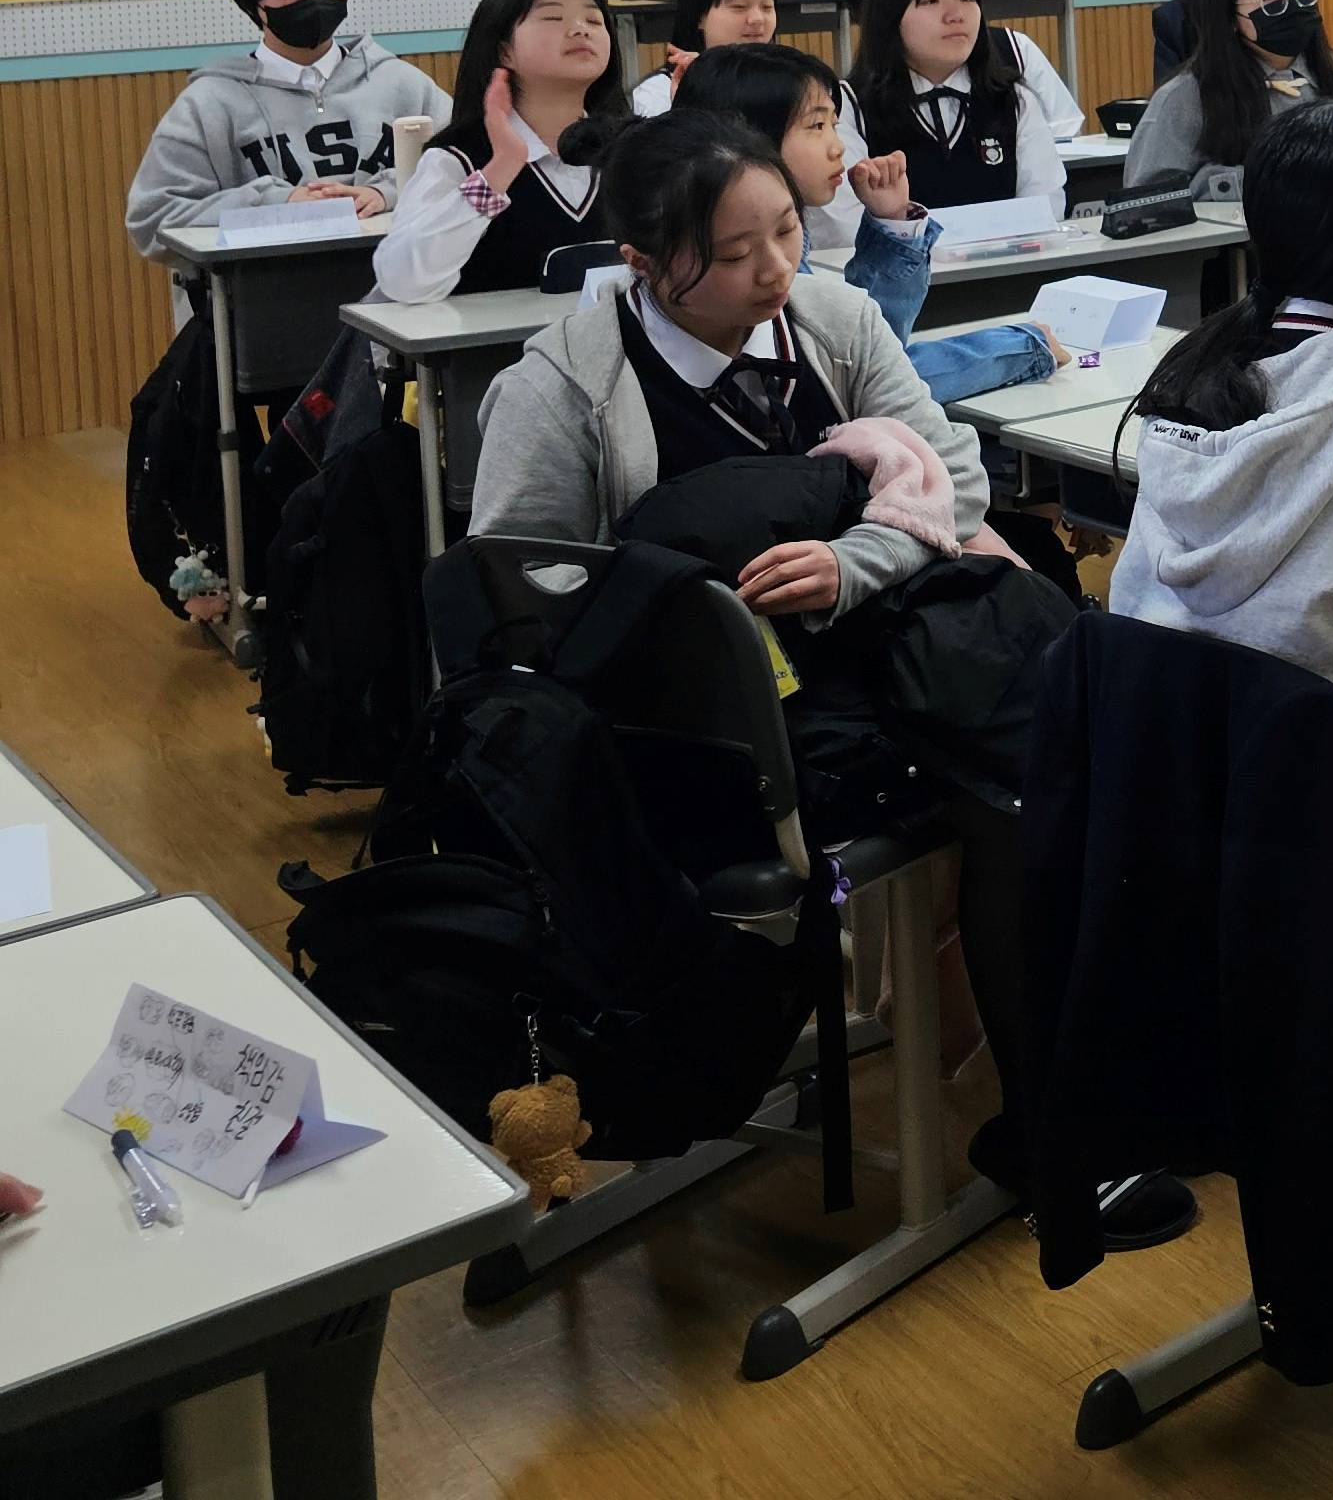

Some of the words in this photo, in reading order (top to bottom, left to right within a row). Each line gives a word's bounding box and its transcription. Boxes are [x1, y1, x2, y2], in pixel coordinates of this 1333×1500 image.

[240, 119, 396, 187] USA
[234, 1043, 288, 1104] 책임감
[224, 1100, 264, 1141] 친절
